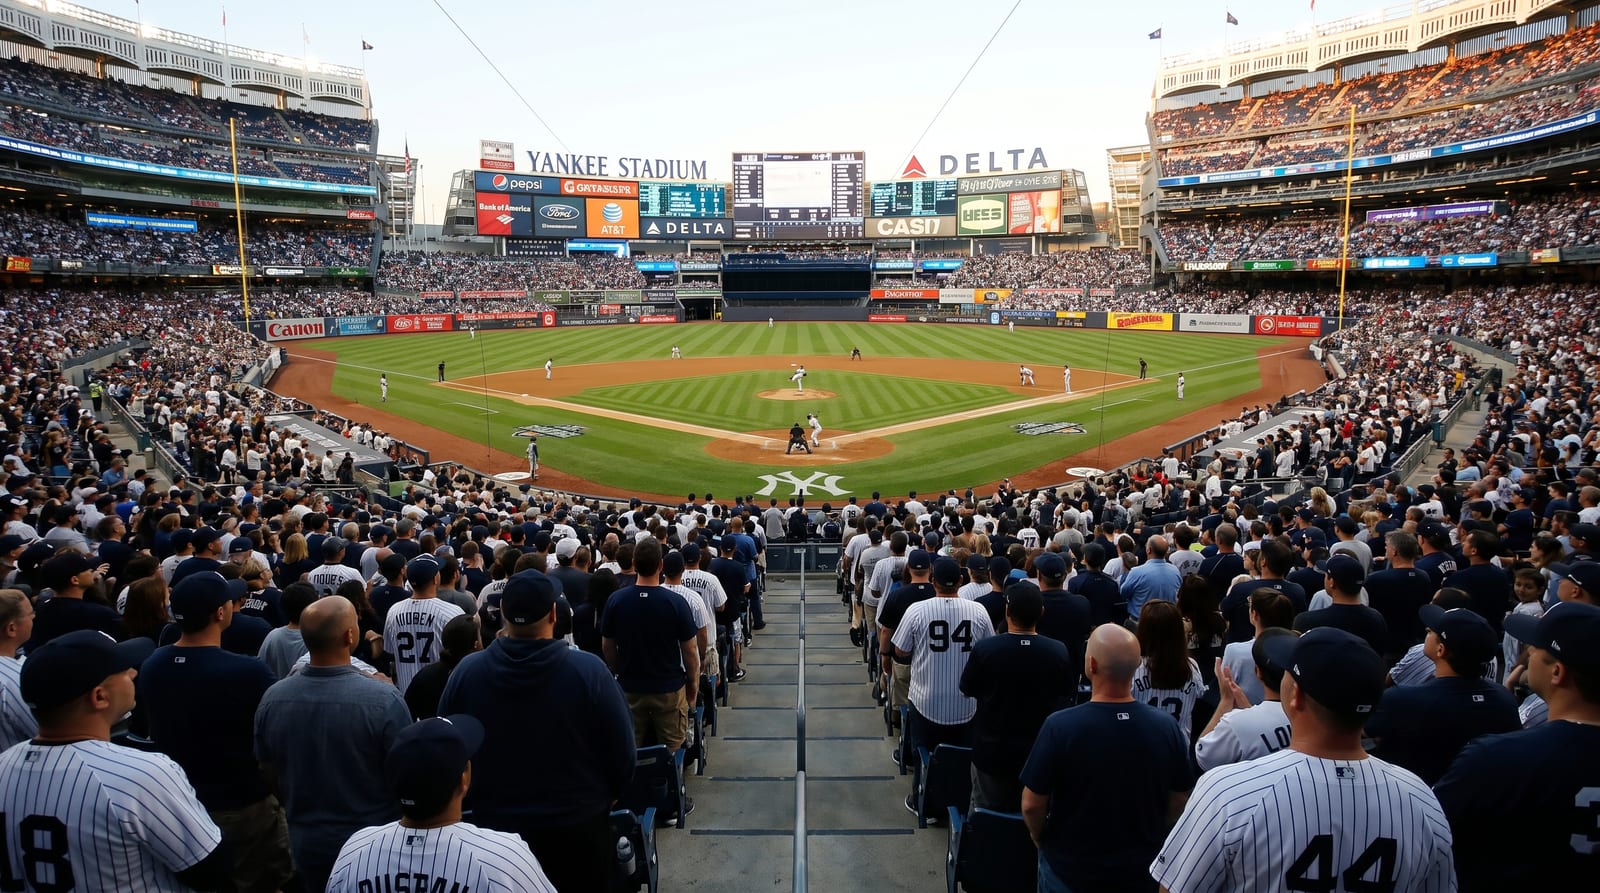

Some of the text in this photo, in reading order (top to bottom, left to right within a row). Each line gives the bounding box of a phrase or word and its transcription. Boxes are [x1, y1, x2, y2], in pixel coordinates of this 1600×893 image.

[526, 150, 609, 176] YANKEE
[618, 156, 707, 180] STADIUM
[939, 147, 1049, 176] DELTA
[510, 179, 543, 191] pepsi
[479, 203, 531, 213] Bank of America
[547, 207, 572, 218] Ford
[601, 225, 626, 235] AT&T
[666, 222, 725, 235] DELTA
[268, 322, 323, 338] Canon
[928, 619, 973, 652] 94
[396, 631, 435, 663] 27
[1285, 833, 1398, 893] 44
